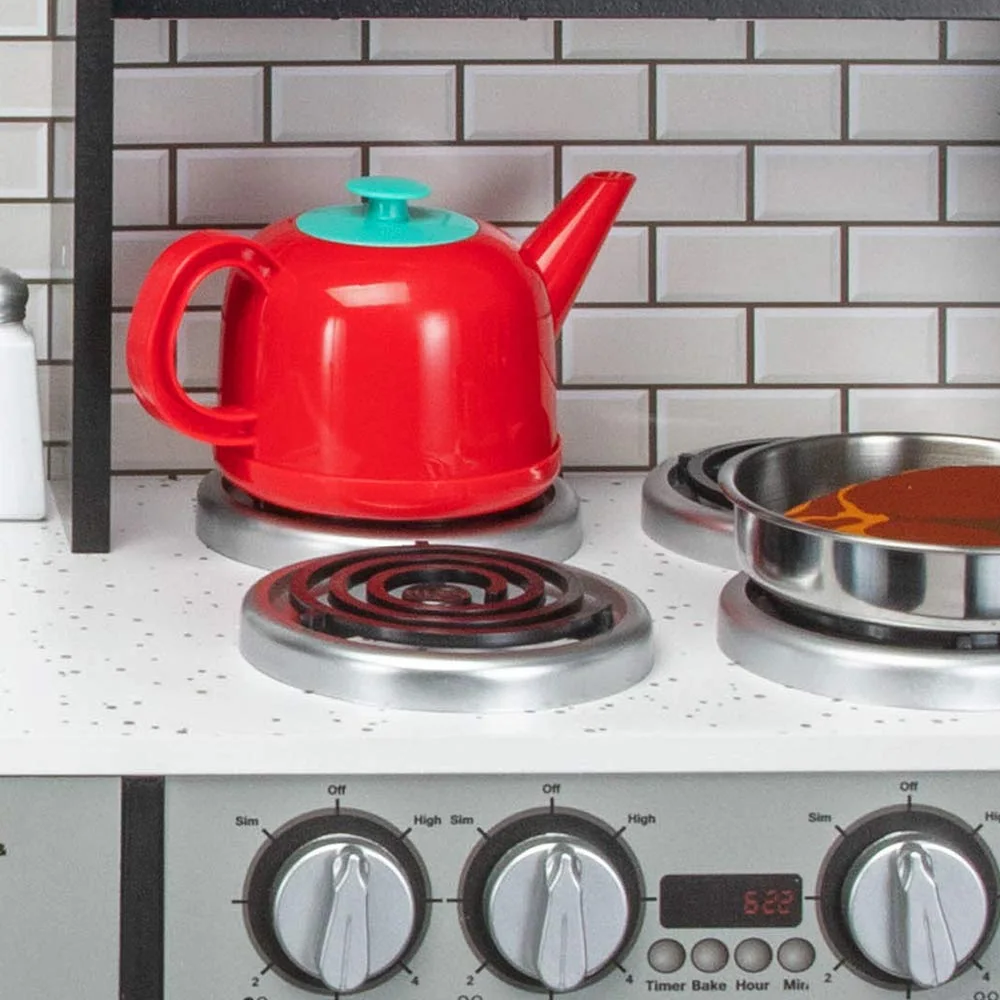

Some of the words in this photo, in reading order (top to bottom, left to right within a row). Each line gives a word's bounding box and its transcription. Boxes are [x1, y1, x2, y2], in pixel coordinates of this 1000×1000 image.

[327, 784, 347, 796] Off
[542, 783, 561, 794] Off
[899, 781, 919, 792] Off
[235, 815, 259, 827] Sim
[413, 814, 442, 828] High
[450, 814, 474, 826] Sim
[628, 813, 657, 825] High
[807, 811, 832, 823] Sim
[251, 976, 260, 988] 2
[411, 975, 420, 987] 4
[466, 974, 475, 986] 2
[625, 973, 634, 985] 4
[823, 973, 832, 984] 2
[982, 971, 991, 982] 4
[645, 979, 687, 992] Timer
[691, 979, 727, 992] Bake
[735, 979, 771, 992] Hour
